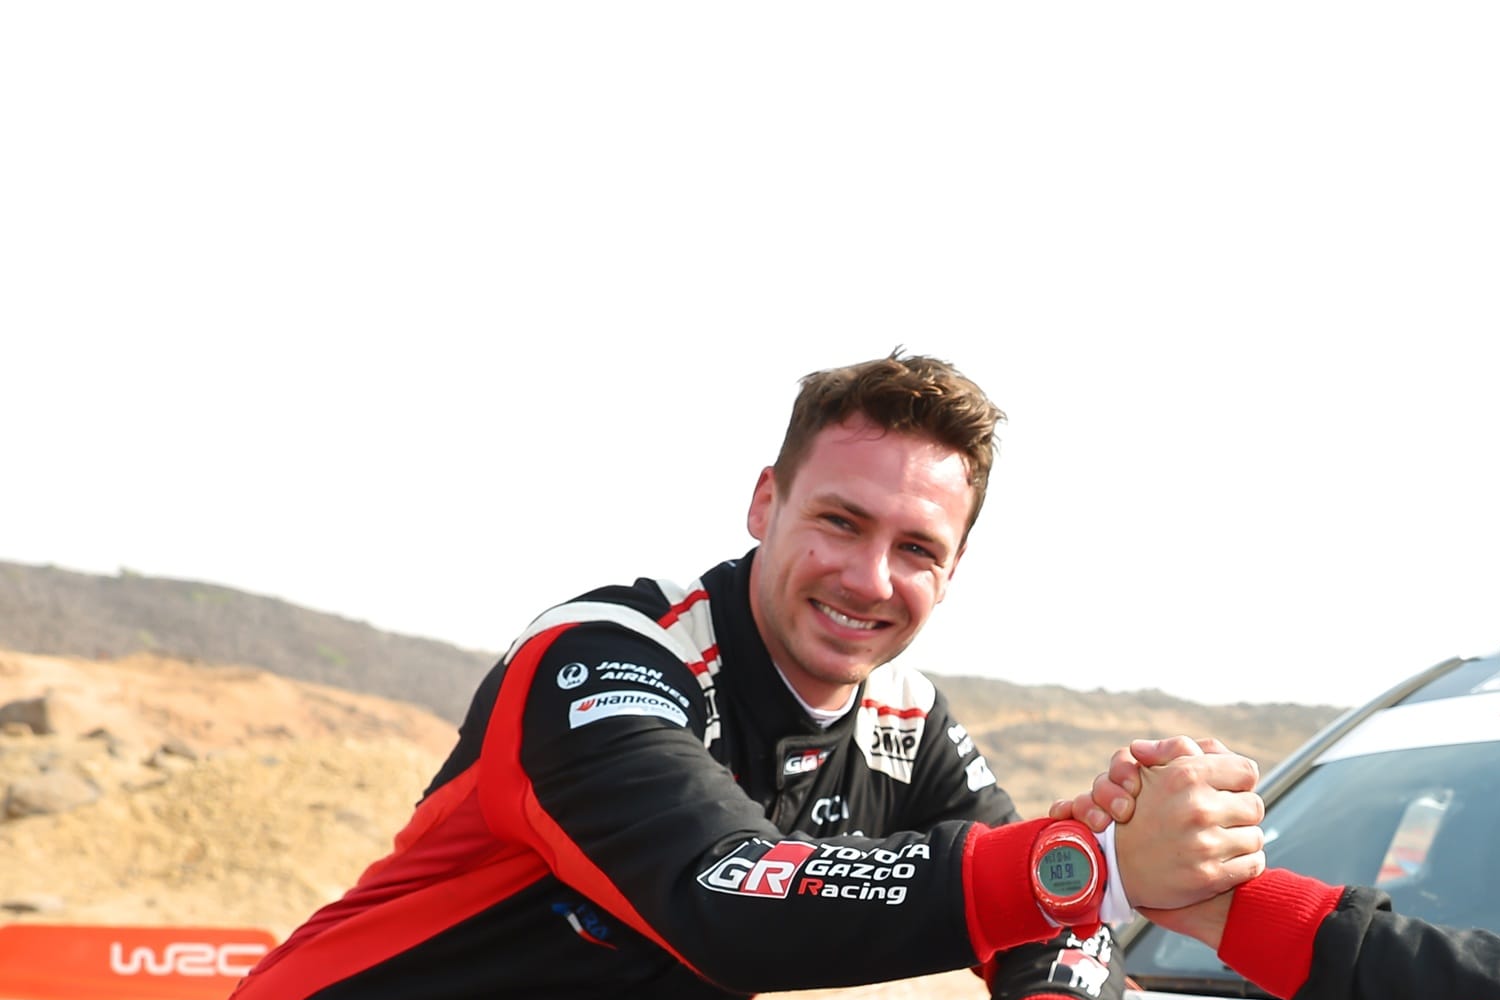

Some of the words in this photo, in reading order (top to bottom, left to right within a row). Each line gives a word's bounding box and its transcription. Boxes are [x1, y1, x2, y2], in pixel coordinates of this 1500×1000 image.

[596, 661, 663, 680] JAPAN
[600, 671, 690, 708] AIRLINES
[707, 857, 796, 894] GR
[805, 859, 916, 881] GAZOO
[797, 877, 908, 905] Racing
[110, 941, 269, 978] WRC
